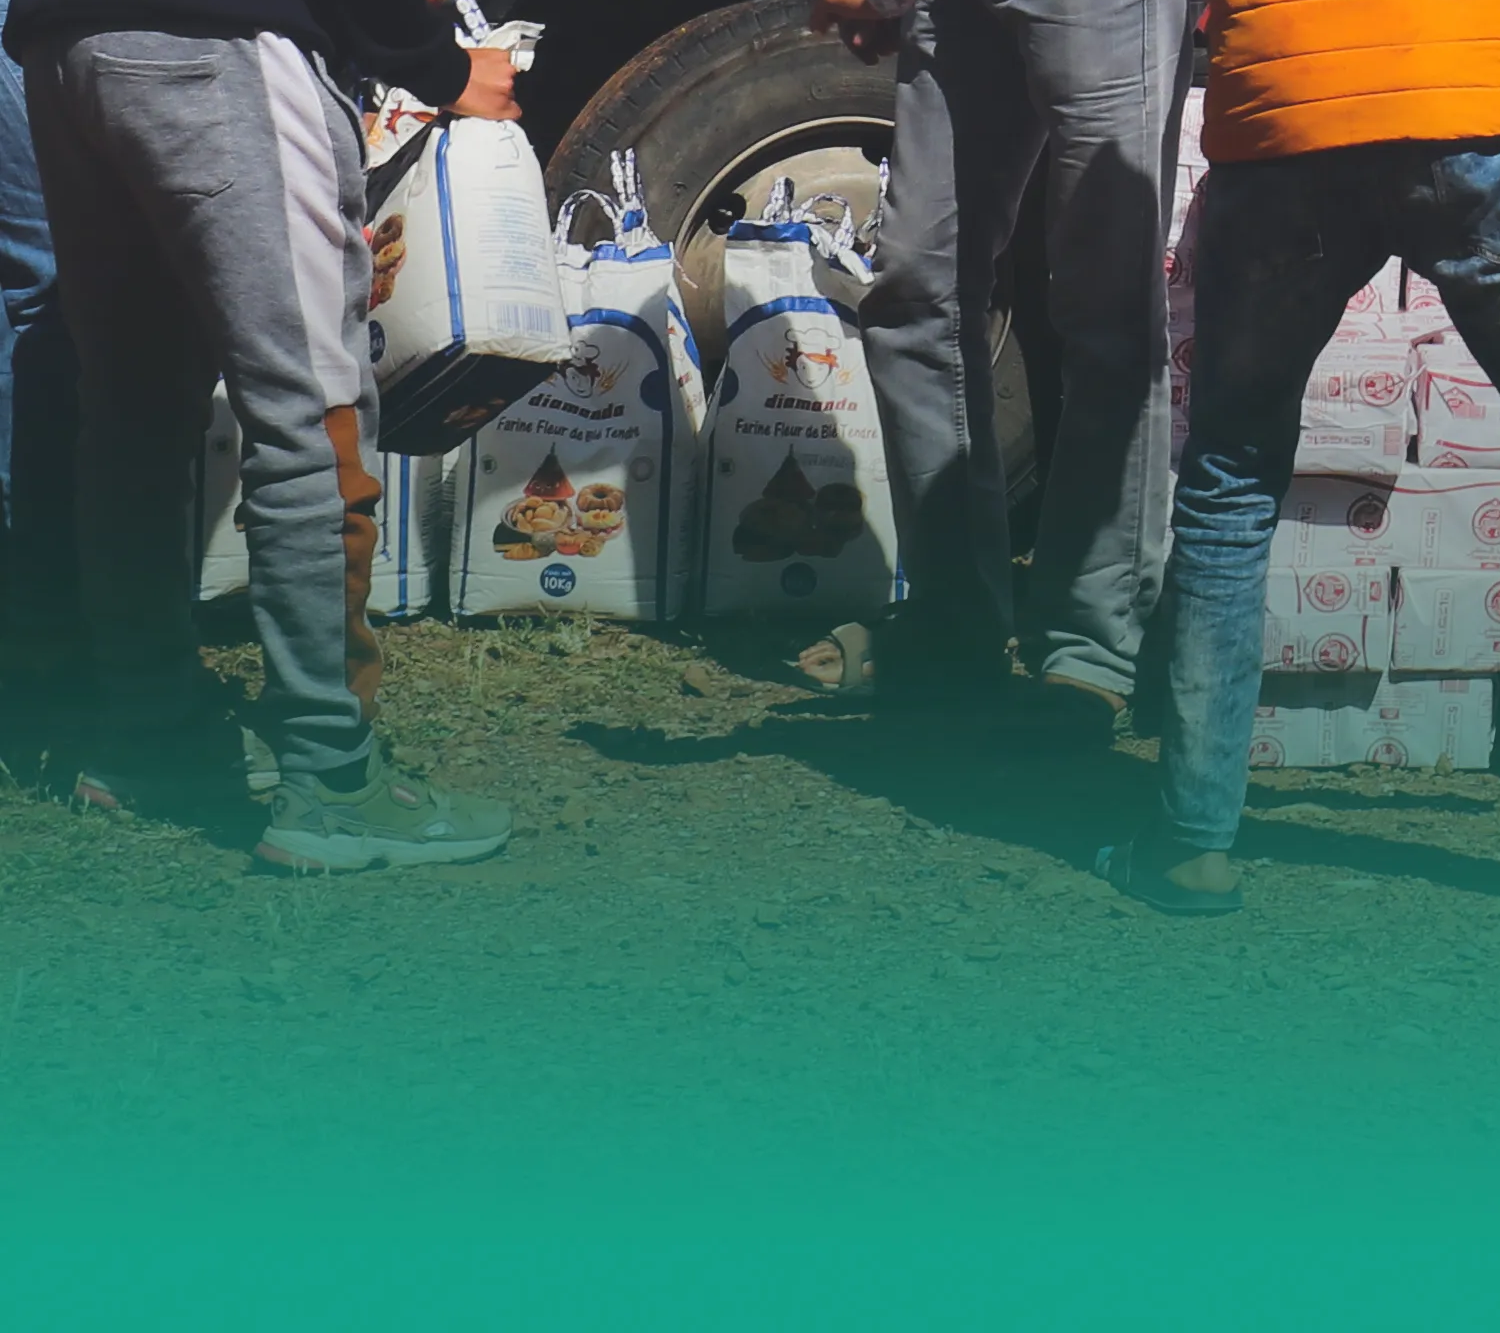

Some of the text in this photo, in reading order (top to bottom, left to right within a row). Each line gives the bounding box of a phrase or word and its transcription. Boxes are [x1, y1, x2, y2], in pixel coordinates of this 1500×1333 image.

[497, 417, 534, 434] Farine
[536, 419, 568, 437] Fleur
[569, 427, 584, 441] de
[735, 418, 771, 436] Farine
[774, 420, 803, 437] Fleur
[805, 423, 819, 438] de
[543, 576, 573, 593] 10Kg
